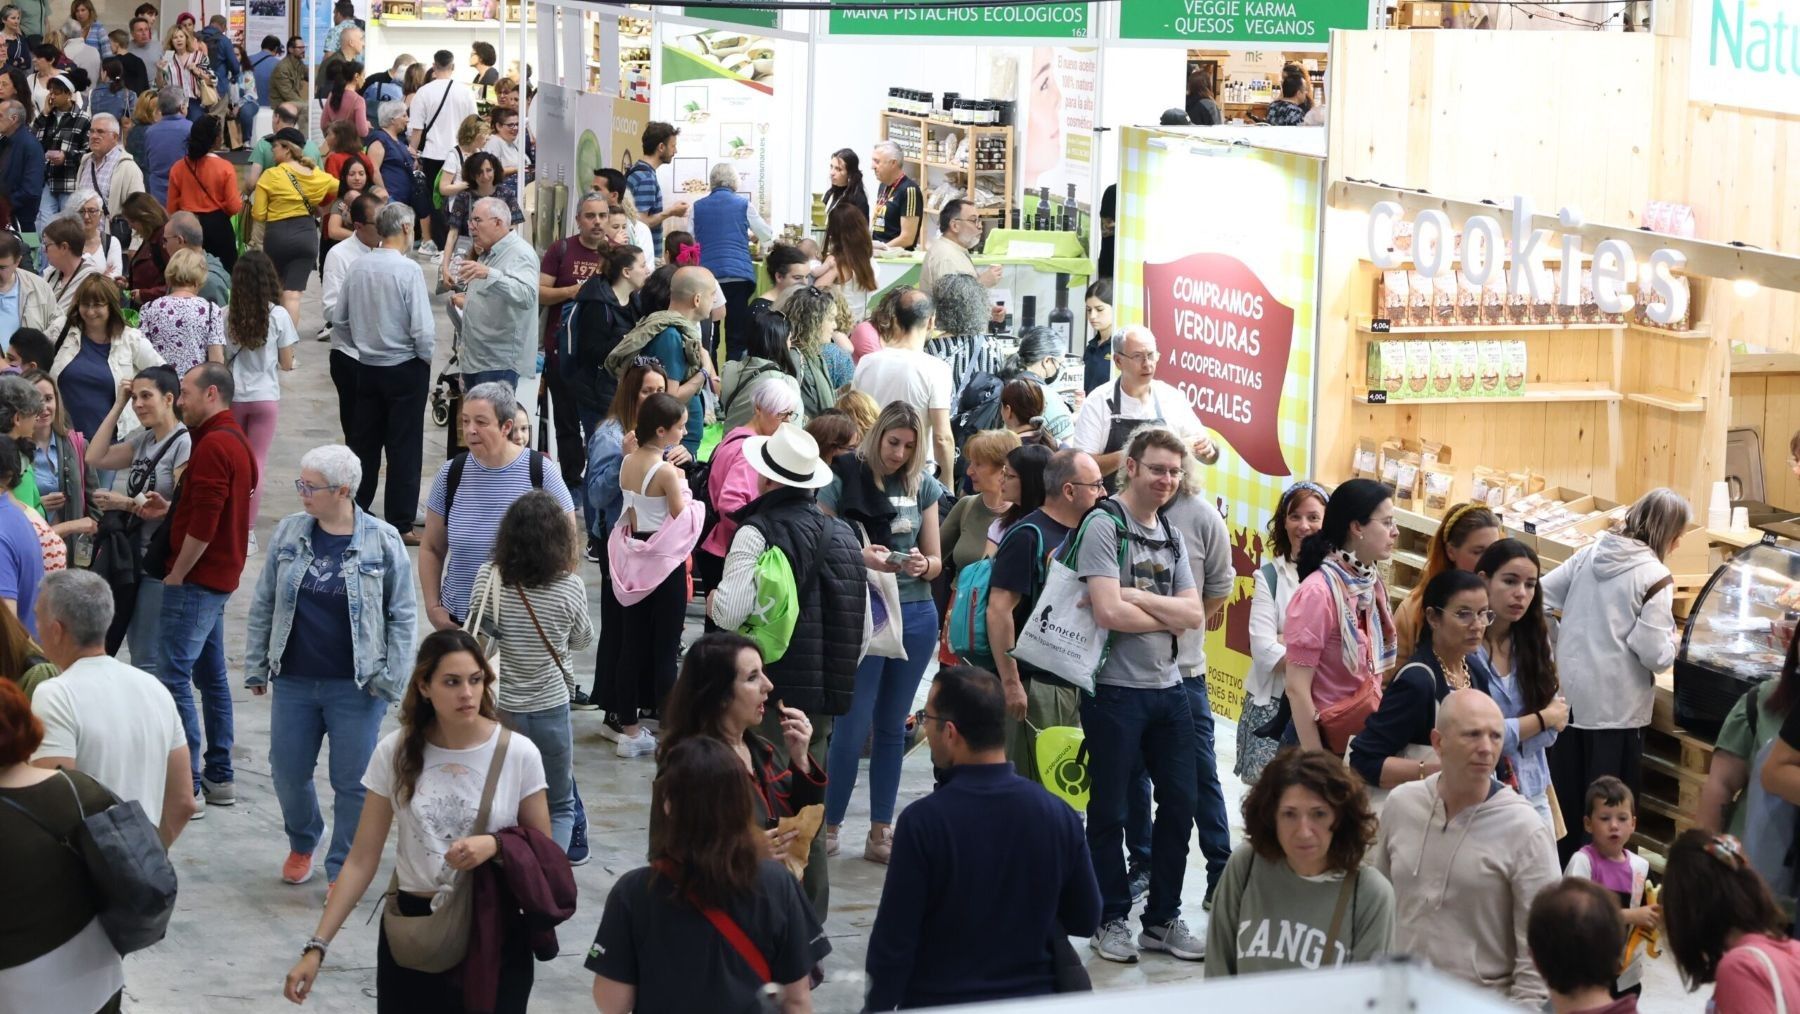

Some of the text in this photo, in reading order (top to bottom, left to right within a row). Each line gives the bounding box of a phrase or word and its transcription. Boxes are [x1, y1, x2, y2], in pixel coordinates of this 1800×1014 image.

[893, 8, 978, 21] PISTACHOS
[984, 7, 1083, 24] ECOLOGICOS
[1184, 0, 1297, 18] VEGGIE KARMA
[1071, 28, 1088, 38] 162
[1175, 17, 1235, 34] QUESOS
[1245, 19, 1315, 36] VEGANOS
[1075, 78, 1094, 92] natural
[1368, 195, 1691, 324] cookies
[1173, 276, 1264, 320] COMPRAMOS
[1174, 308, 1261, 357] VERDURAS
[1169, 348, 1263, 390] A COOPERATIVAS
[1177, 380, 1252, 424] SOCIALES
[1208, 665, 1243, 690] POSITIVO
[1208, 699, 1233, 720] OCIAL
[1228, 691, 1238, 705] EN
[1236, 918, 1350, 970] KANG
